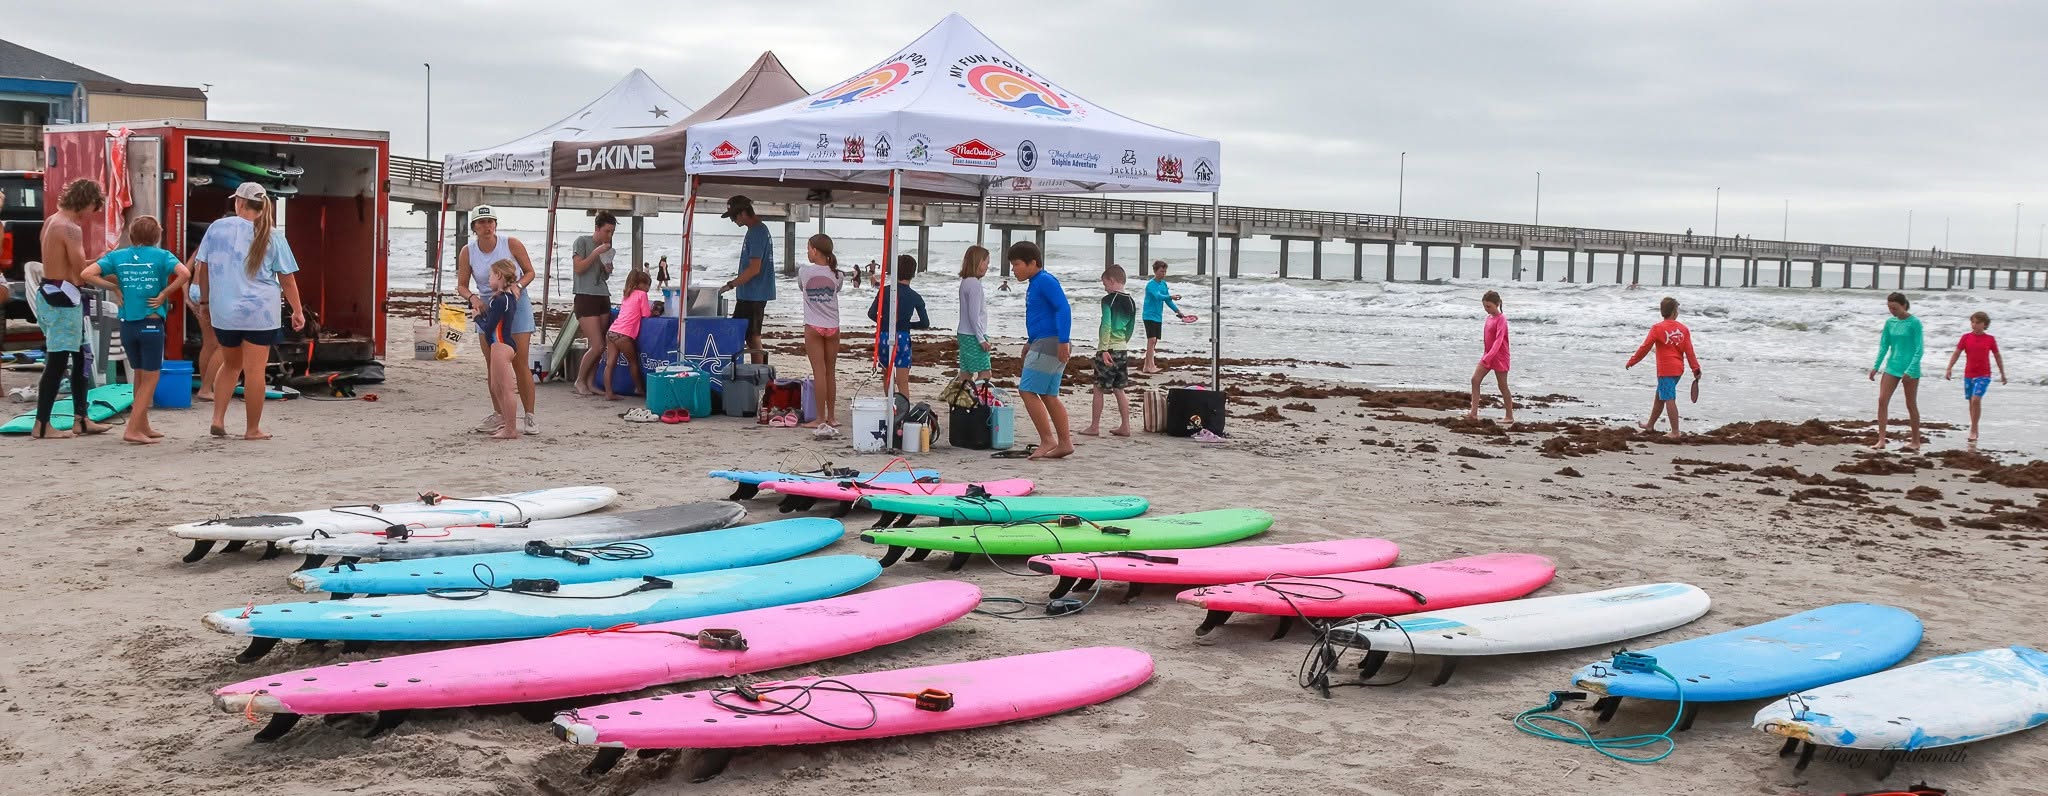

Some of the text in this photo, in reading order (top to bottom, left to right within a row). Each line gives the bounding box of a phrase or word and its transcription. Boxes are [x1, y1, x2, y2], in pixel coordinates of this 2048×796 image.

[949, 64, 964, 79] MY
[958, 54, 988, 67] FUN
[991, 56, 1033, 78] PORT
[576, 144, 656, 172] DAKINE
[807, 150, 837, 160] jackfish
[876, 148, 888, 158] FINS
[461, 153, 534, 177] Texas Surf Camps
[1052, 158, 1097, 168] Dolphin Adventure
[1109, 166, 1148, 177] jackfish
[1197, 172, 1211, 181] FINS
